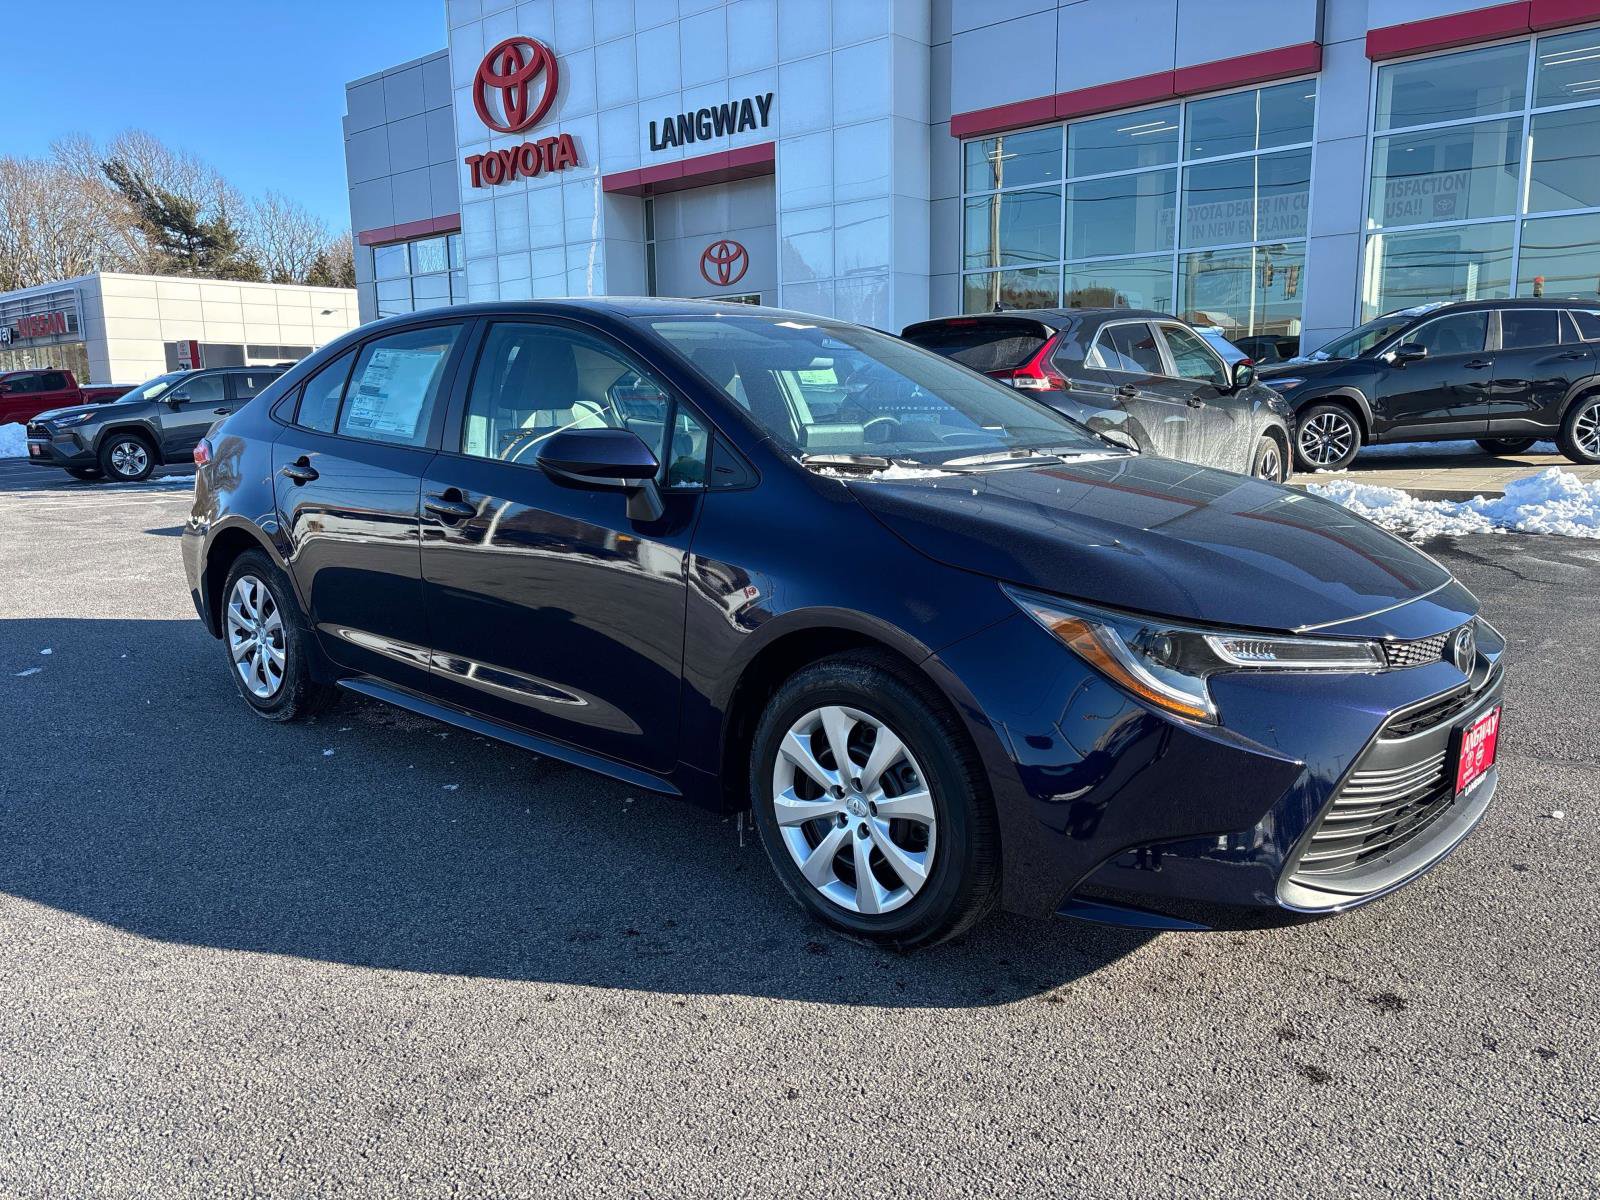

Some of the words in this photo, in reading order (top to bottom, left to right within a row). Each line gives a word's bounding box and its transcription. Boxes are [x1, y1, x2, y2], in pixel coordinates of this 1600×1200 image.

[649, 92, 773, 151] LANGWAY
[465, 133, 578, 188] TOYOTA
[1187, 204, 1223, 221] OYOTA
[1274, 197, 1288, 212] IN
[1385, 174, 1467, 199] TISFACTION
[1192, 223, 1204, 240] IN
[1208, 221, 1235, 237] NEW
[16, 311, 69, 336] NISSAN
[1460, 710, 1499, 760] LANGWAY
